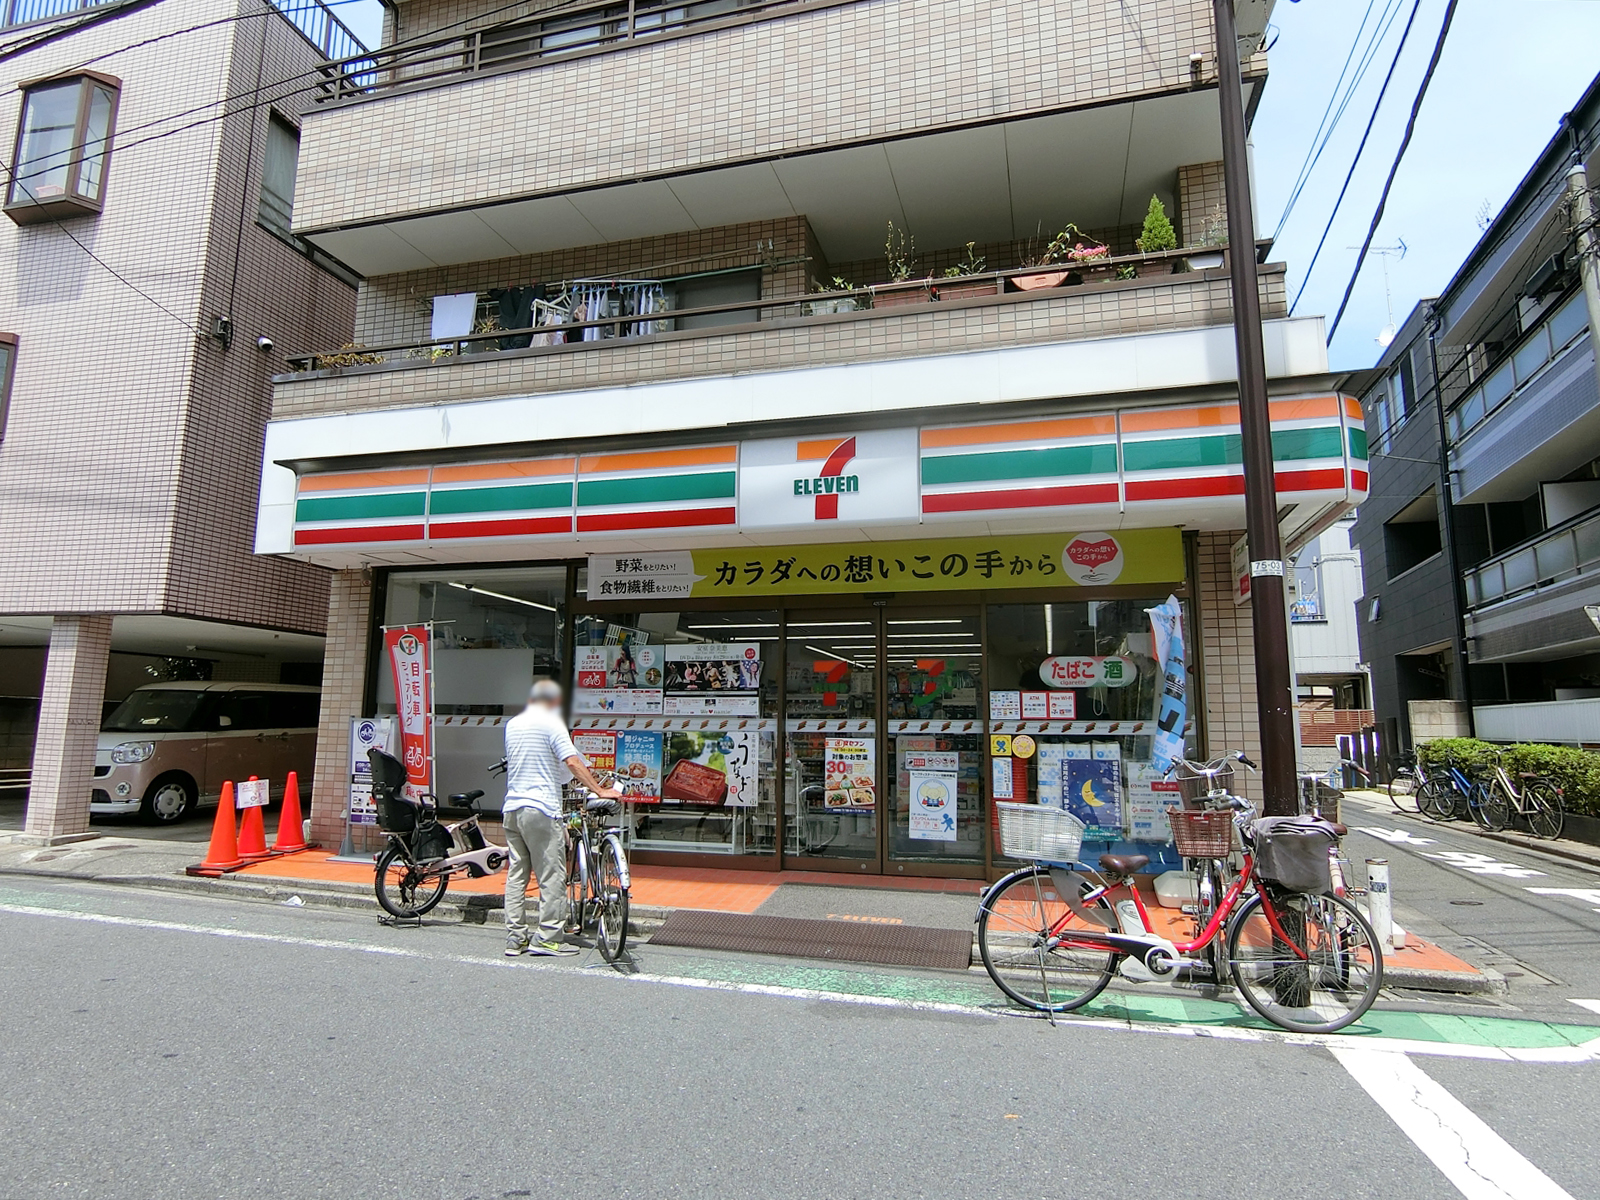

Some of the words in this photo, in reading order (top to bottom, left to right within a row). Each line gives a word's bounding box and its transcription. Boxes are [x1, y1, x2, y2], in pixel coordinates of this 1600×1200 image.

[1051, 660, 1095, 680] たばこ
[1103, 660, 1123, 679] 酒
[411, 661, 422, 717] 自転車
[596, 757, 615, 768] 無料
